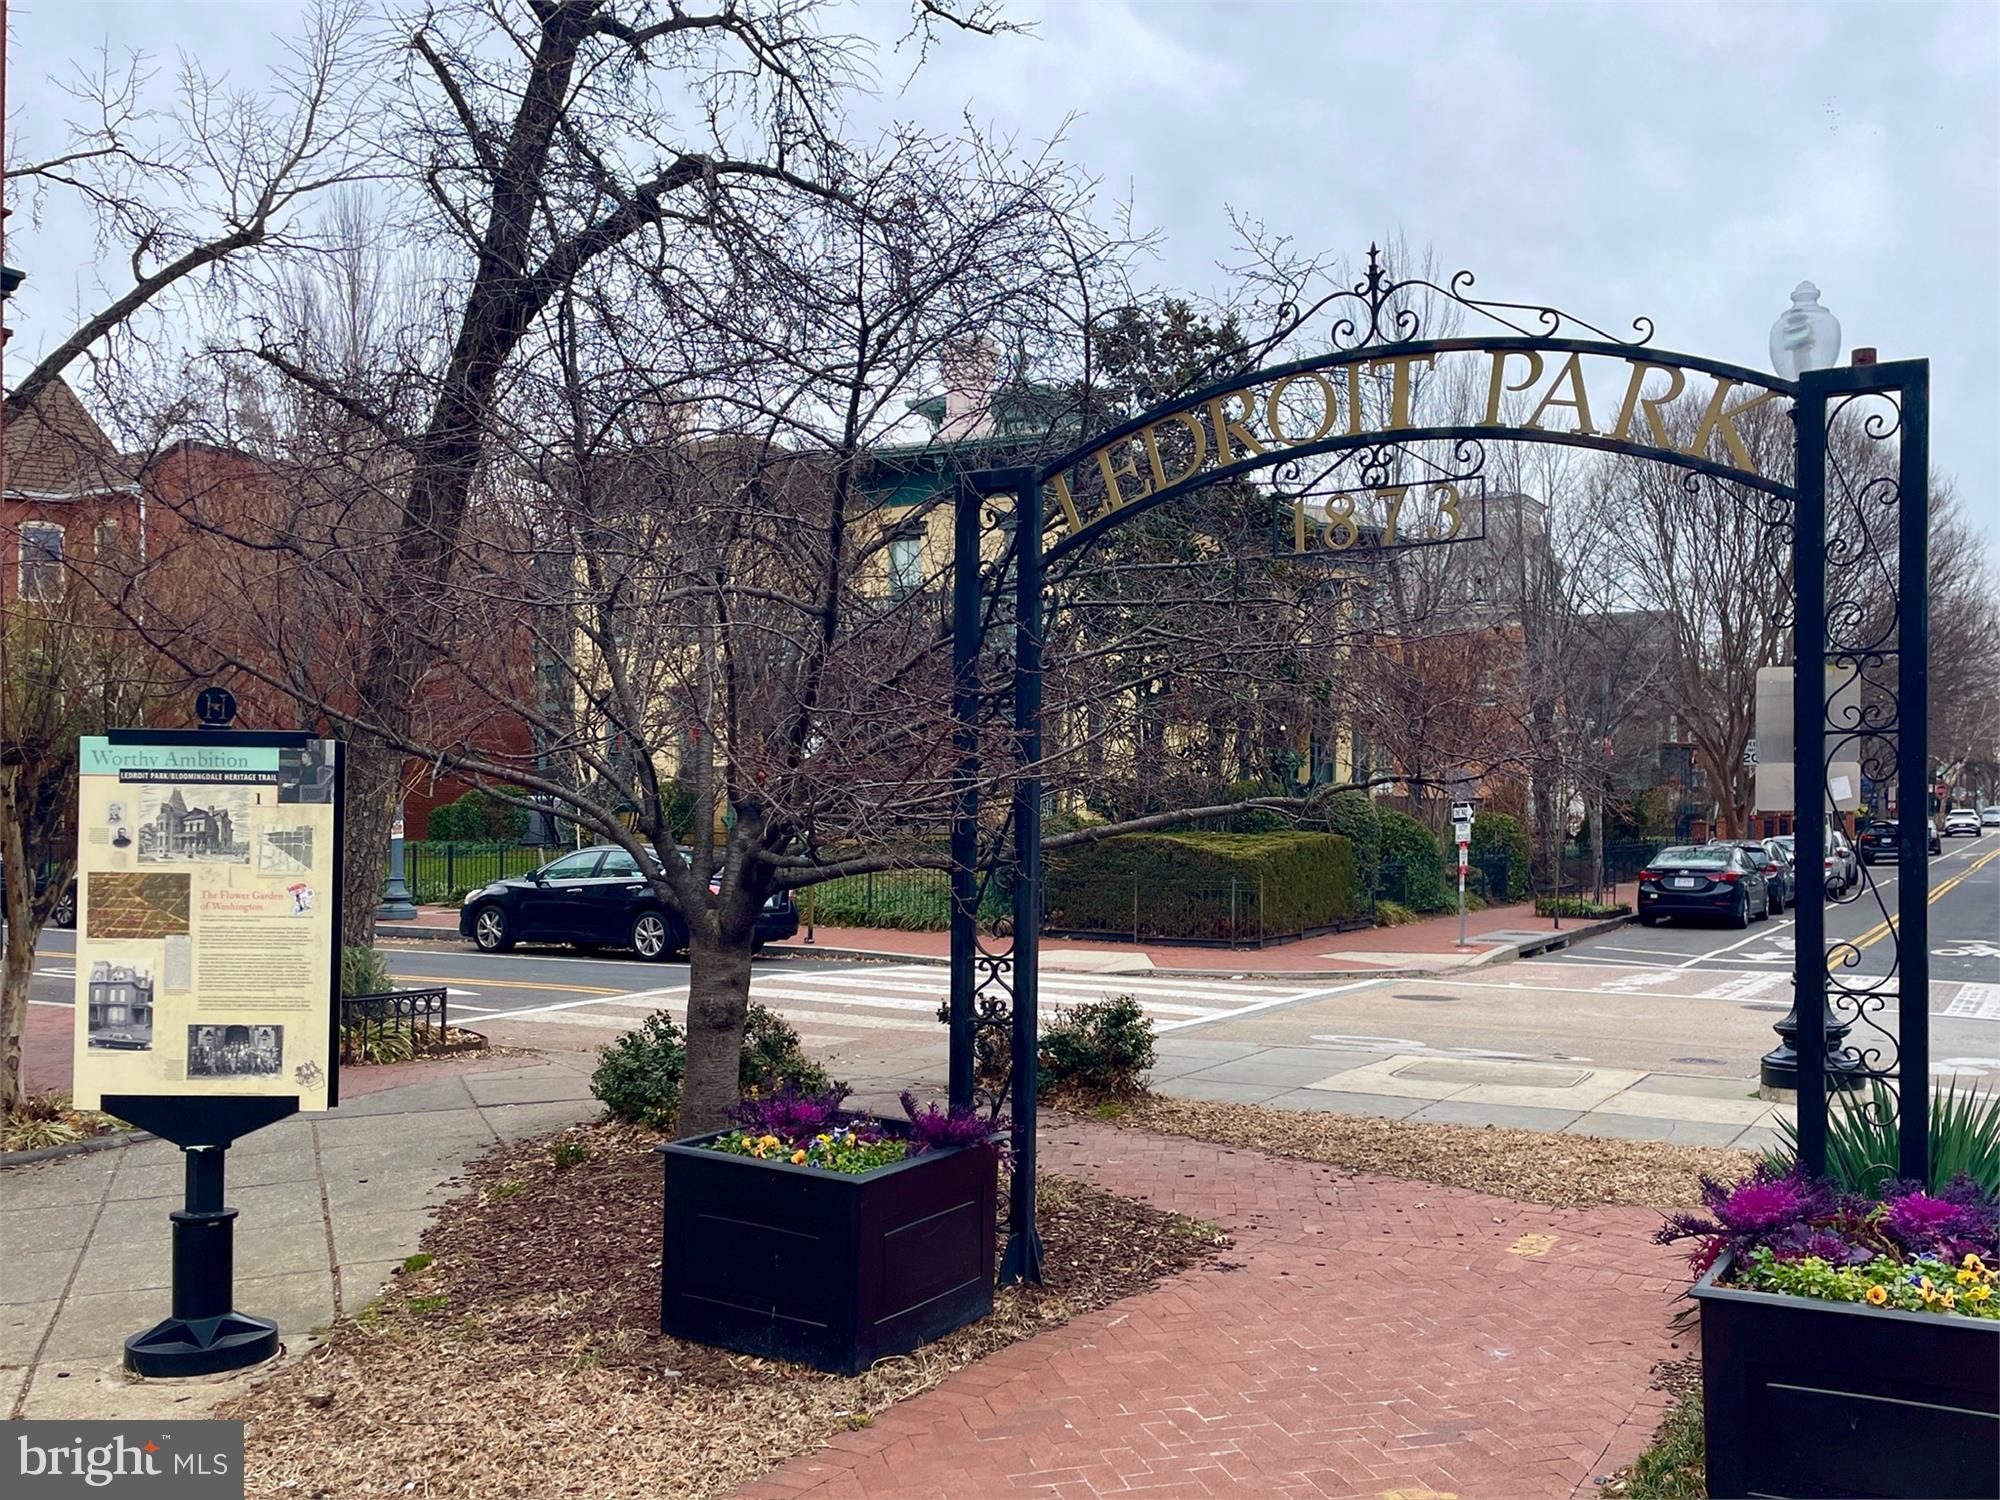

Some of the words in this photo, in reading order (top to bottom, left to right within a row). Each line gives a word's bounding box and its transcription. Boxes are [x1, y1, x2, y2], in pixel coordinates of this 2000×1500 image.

[1051, 353, 1436, 534] LEDROIT
[1474, 349, 1789, 474] PARK
[1292, 483, 1462, 553] 1873
[92, 749, 160, 770] Worthy
[165, 751, 248, 768] Ambition
[120, 772, 148, 780] LEDROIT
[150, 773, 222, 781] PARK/BLOOMINGDALE
[258, 774, 278, 782] TRAIL
[256, 793, 261, 805] 1
[200, 890, 217, 899] The
[220, 890, 250, 899] Flower
[252, 890, 284, 900] Garden
[200, 901, 210, 910] of
[211, 902, 264, 913] Washington
